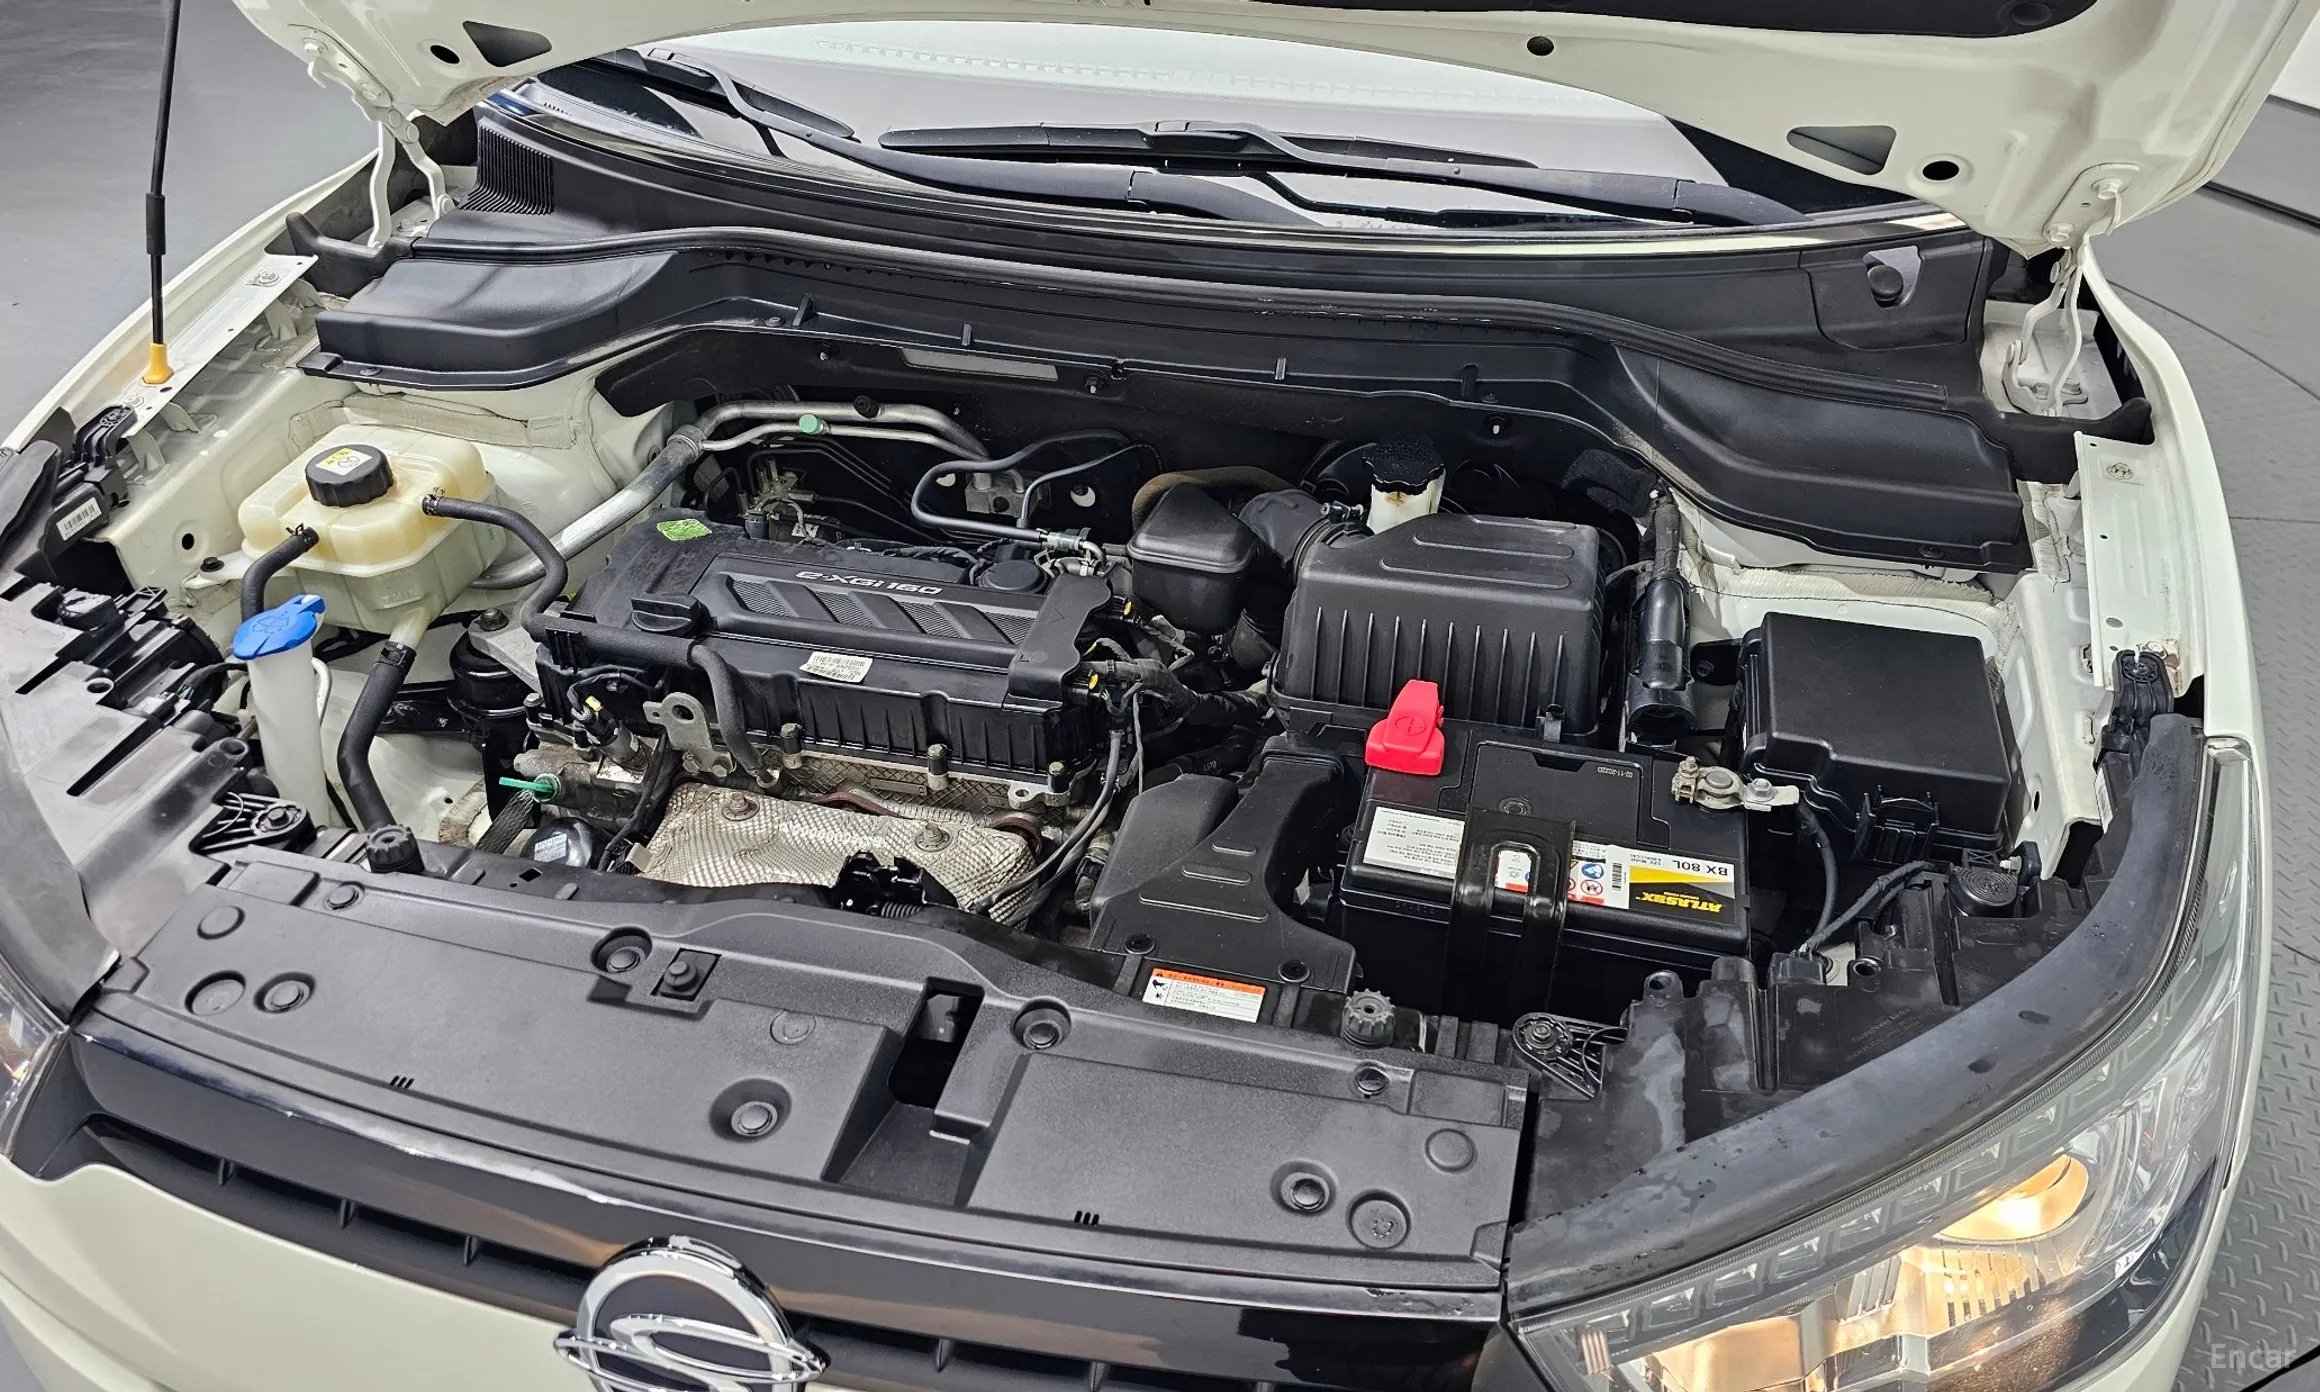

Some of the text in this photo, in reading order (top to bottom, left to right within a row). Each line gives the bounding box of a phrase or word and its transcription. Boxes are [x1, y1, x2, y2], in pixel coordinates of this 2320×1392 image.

[886, 581, 943, 595] 160
[1672, 859, 1728, 876] BX 80L
[1642, 892, 1722, 913] ATLASBX
